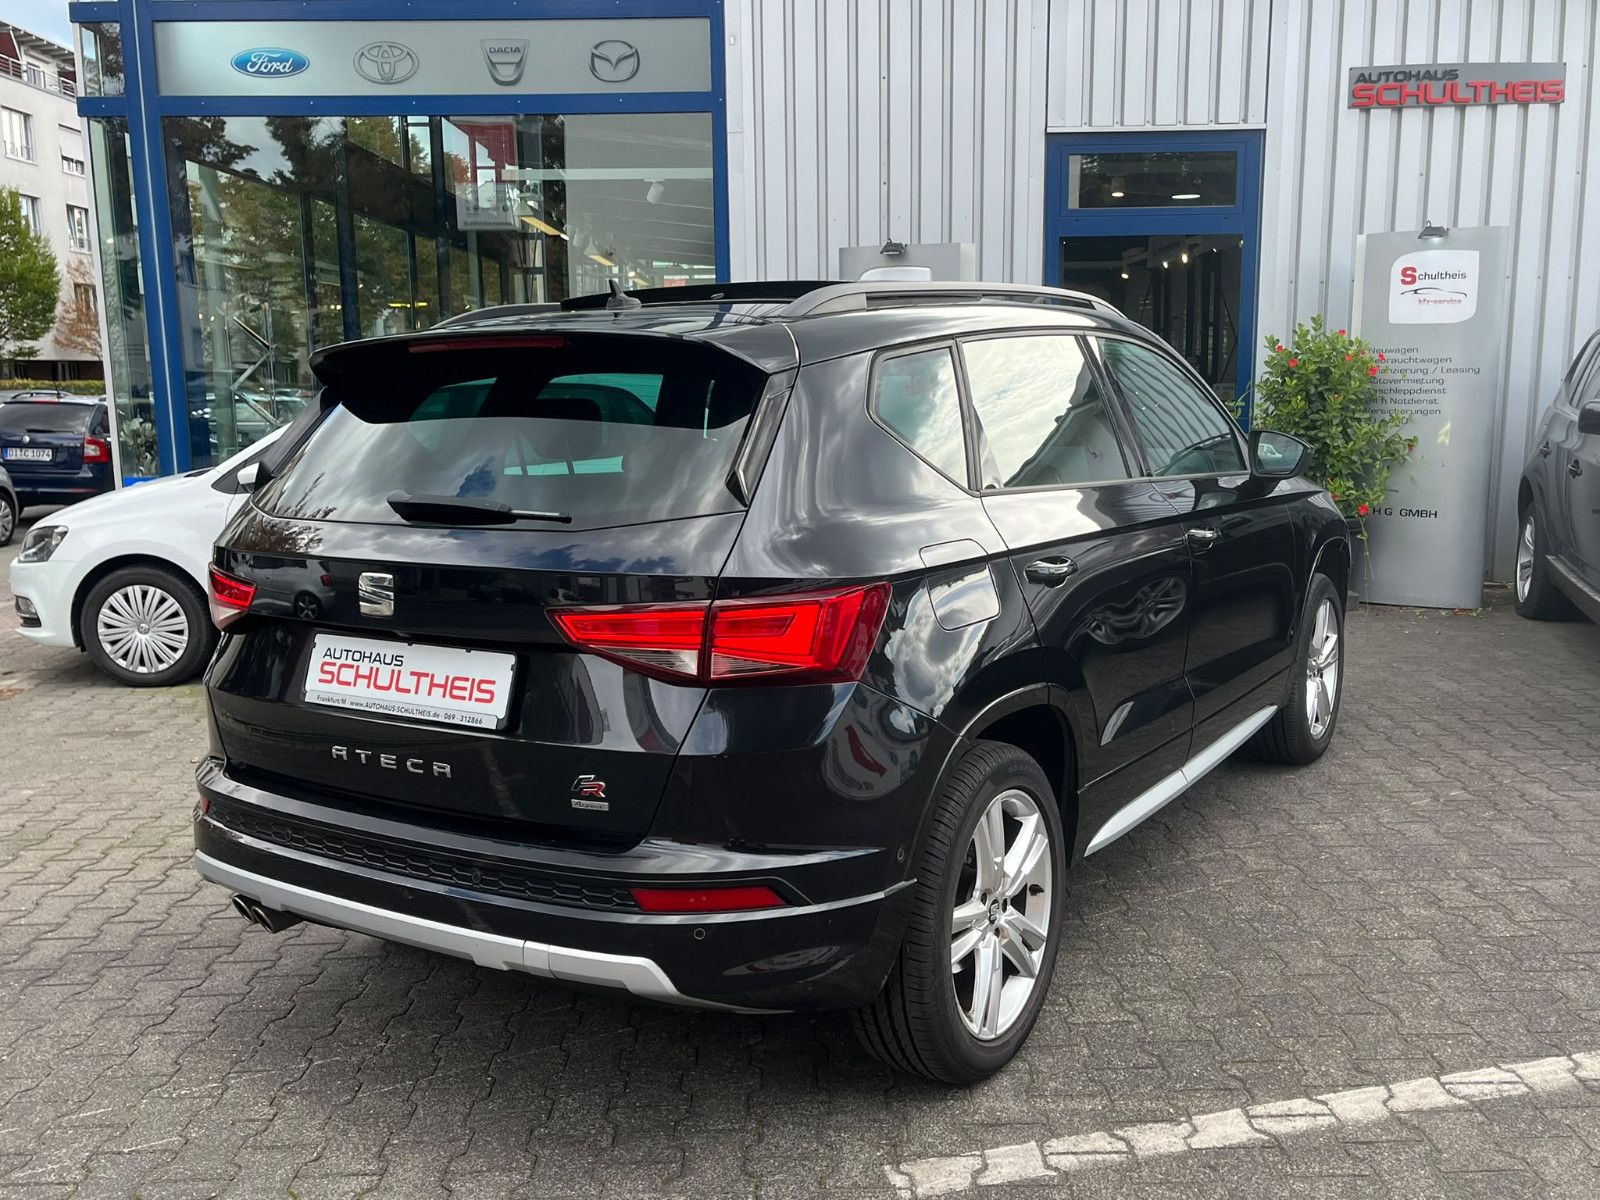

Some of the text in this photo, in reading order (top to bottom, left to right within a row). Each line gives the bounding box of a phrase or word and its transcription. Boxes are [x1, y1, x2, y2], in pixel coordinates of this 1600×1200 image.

[488, 46, 521, 54] DACIA
[246, 52, 294, 73] Ford
[1354, 68, 1460, 85] AUTOHAUS
[1351, 79, 1564, 108] SCHULTHEIS
[1400, 266, 1467, 286] Schultheis
[1368, 346, 1419, 356] Neuwagen
[1374, 356, 1453, 366] erauchtwagen
[1440, 366, 1481, 376] Leasing
[1370, 377, 1445, 386] utovermietung
[1376, 387, 1447, 396] schleppdienst
[1389, 397, 1439, 405] Notdienst
[1399, 508, 1438, 519] GMBH
[322, 647, 405, 667] AUTOHAUS
[318, 661, 497, 705] SCHULTHEIS
[443, 712, 456, 720] 069
[459, 714, 483, 725] 312866
[331, 745, 452, 778] ATECA
